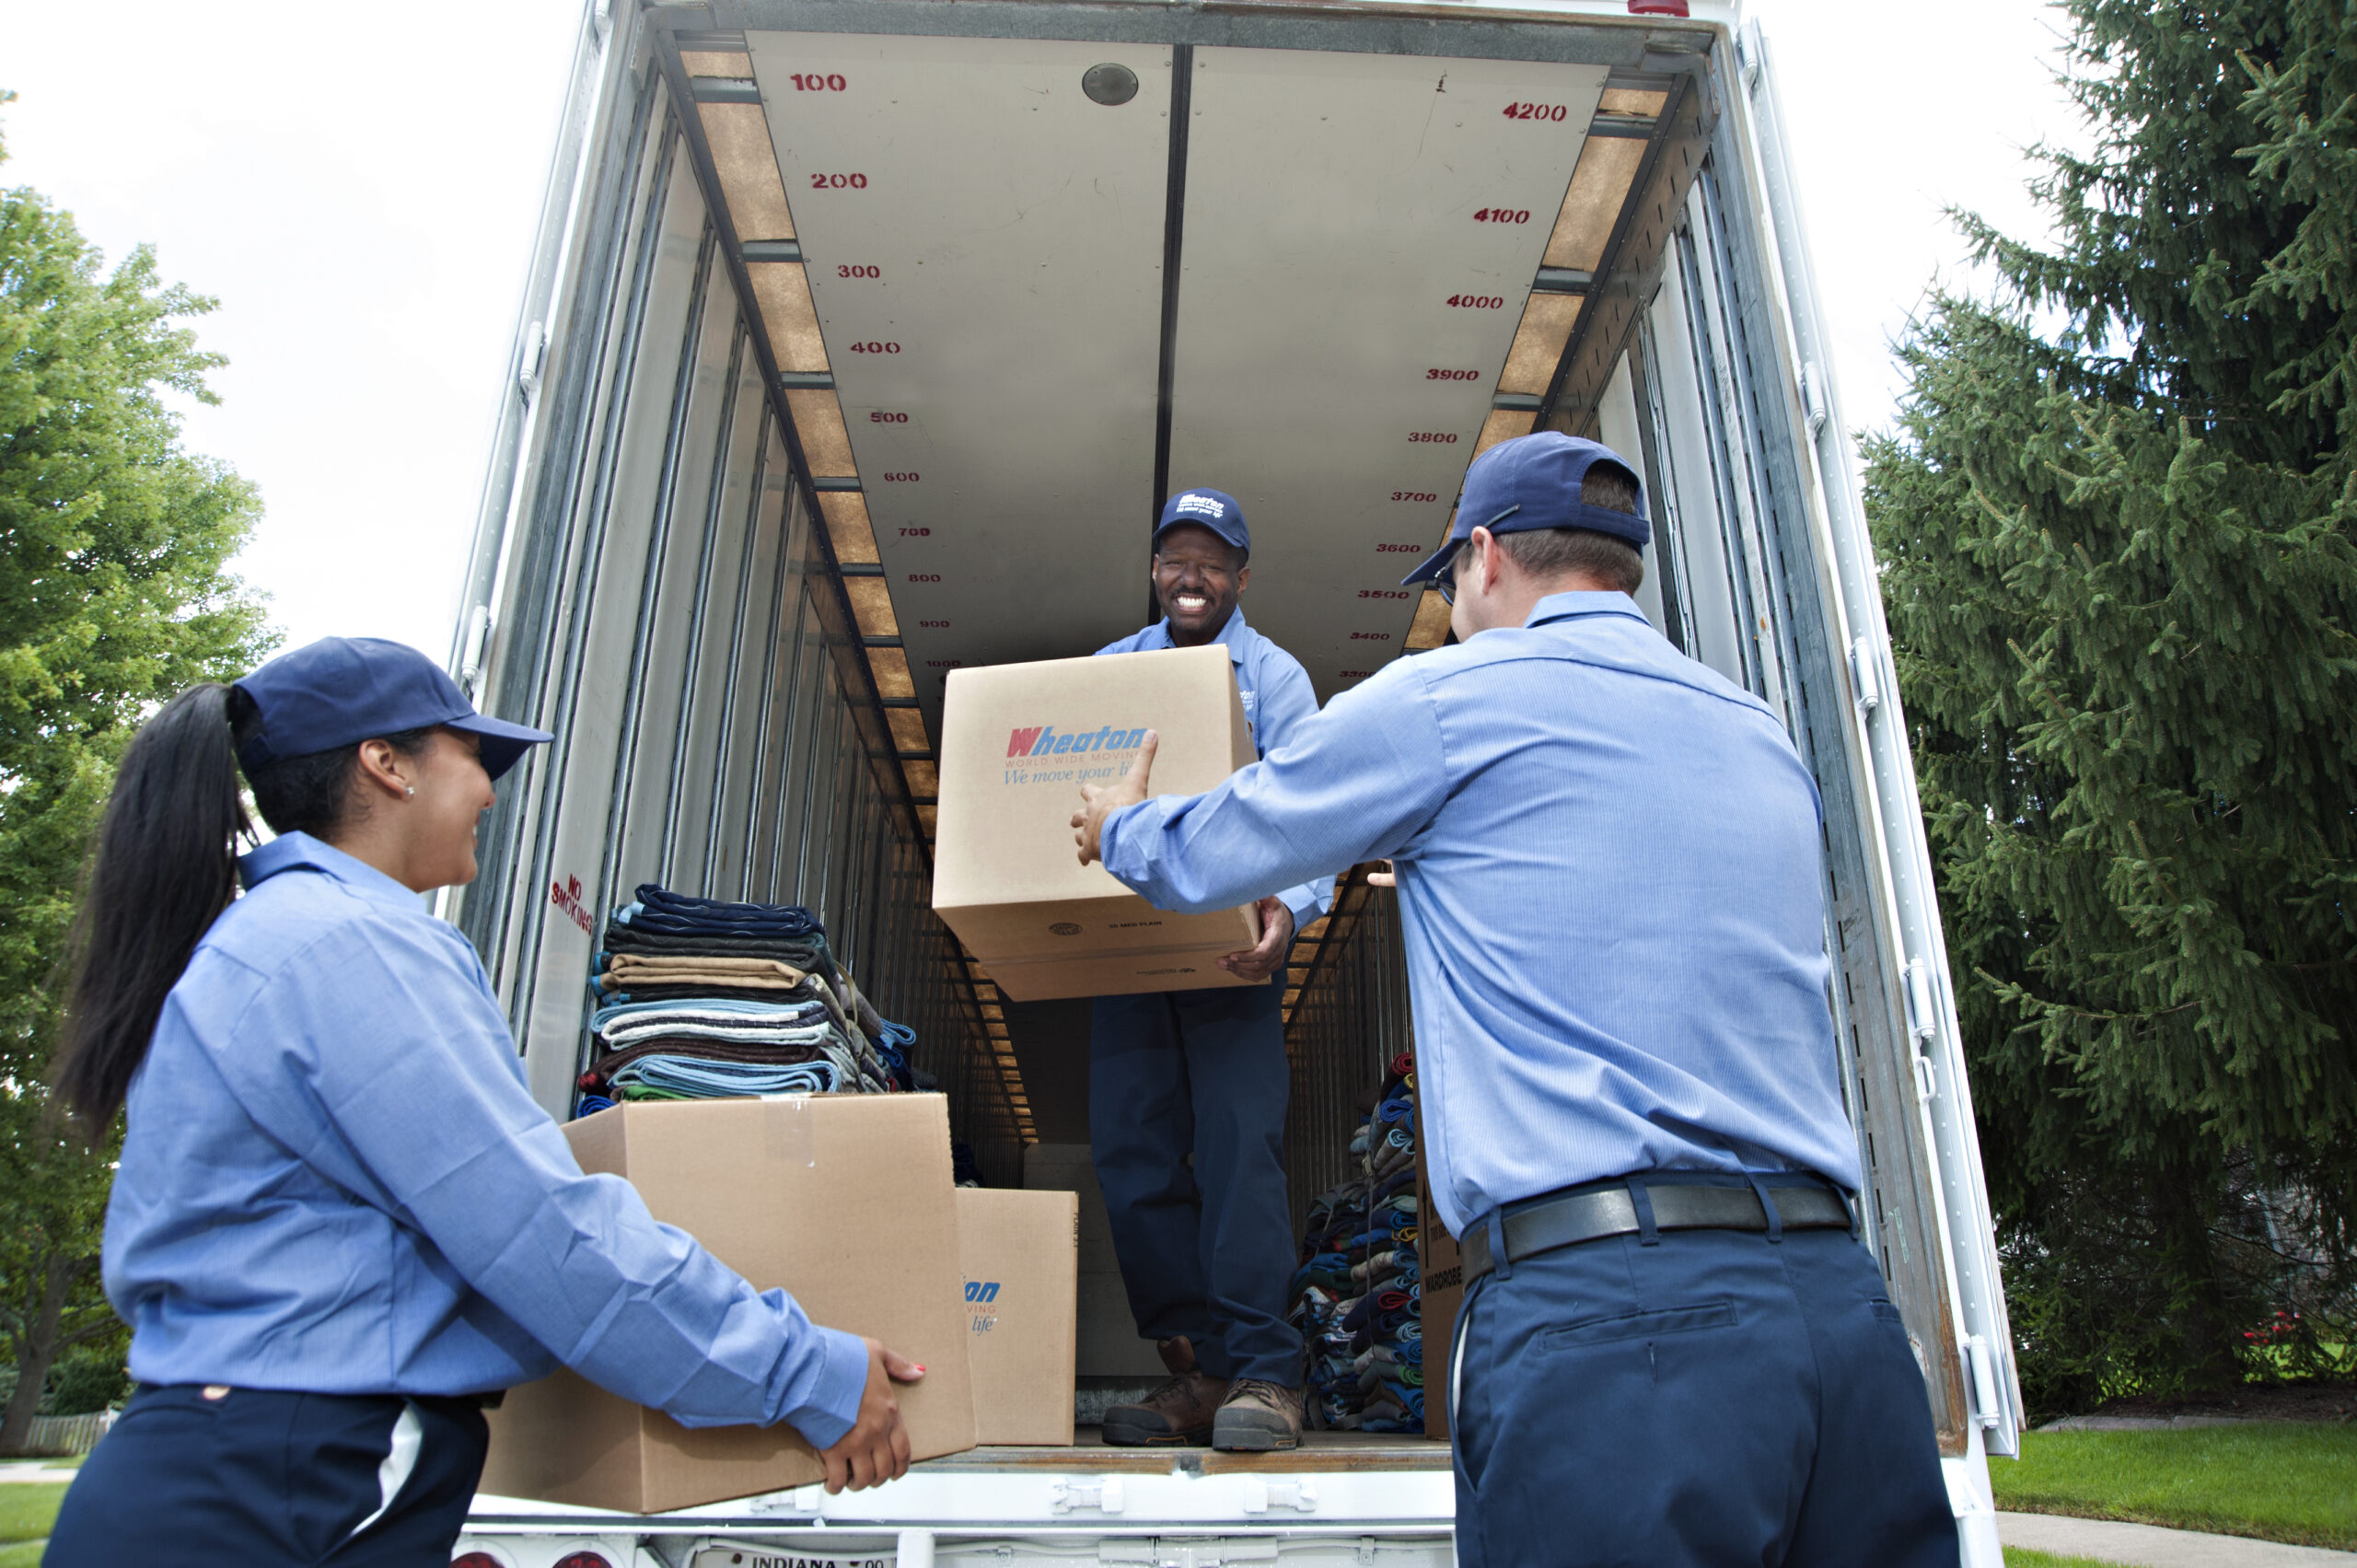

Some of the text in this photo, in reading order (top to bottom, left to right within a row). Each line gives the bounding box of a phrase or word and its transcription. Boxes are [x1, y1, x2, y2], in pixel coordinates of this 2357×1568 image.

[789, 73, 847, 92] 100
[1502, 102, 1567, 122] 4200
[810, 172, 868, 190] 200
[1473, 207, 1530, 225] 4100
[837, 264, 881, 279] 300
[1446, 294, 1504, 310] 4000
[850, 342, 901, 354] 400
[1425, 368, 1480, 381] 3900
[870, 412, 909, 424] 500
[1407, 432, 1457, 444] 3800
[884, 470, 921, 482] 600
[1390, 491, 1437, 503] 3700
[900, 527, 932, 537] 700
[1376, 543, 1422, 553] 3600
[908, 574, 942, 583] 800
[1357, 589, 1411, 599] 3500
[920, 620, 950, 629] 900
[1350, 633, 1390, 641] 3400
[1006, 726, 1148, 758] Wheaton
[1005, 758, 1048, 768] WORLD
[1054, 755, 1086, 765] WIDE
[1004, 770, 1028, 784] We
[1032, 772, 1074, 784] move
[1076, 768, 1114, 784] your
[568, 872, 582, 900] NO
[552, 881, 593, 936] SMOKING
[1424, 1265, 1462, 1294] WARDROBE
[966, 1305, 996, 1314] VING
[972, 1316, 993, 1337] life
